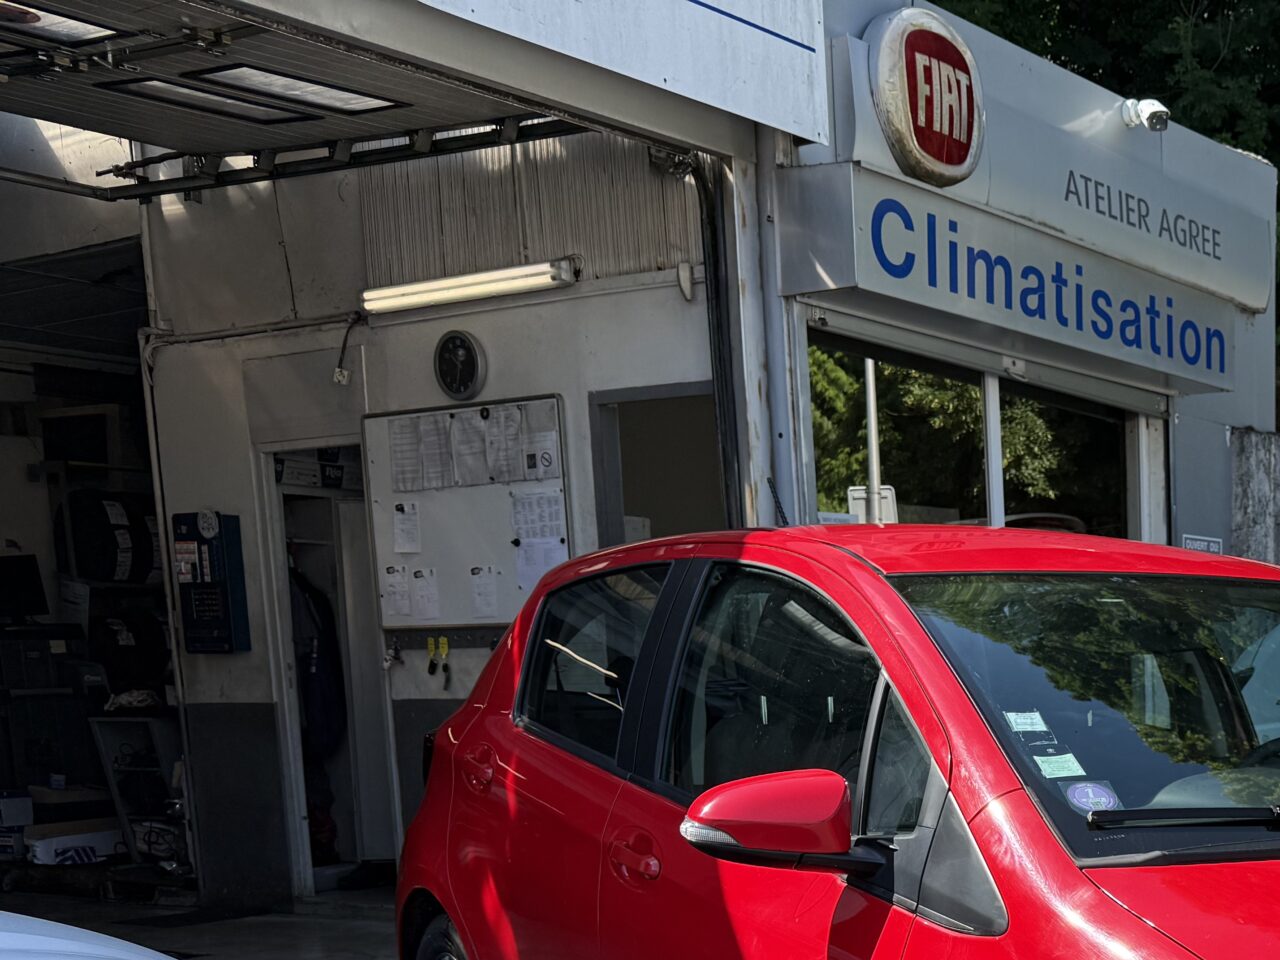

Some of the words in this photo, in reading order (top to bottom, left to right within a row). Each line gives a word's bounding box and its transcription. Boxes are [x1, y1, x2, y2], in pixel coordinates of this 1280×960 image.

[915, 53, 970, 144] FIAT
[1064, 170, 1151, 233] ATELIER
[1158, 208, 1222, 261] AGREE
[871, 198, 1226, 374] Climatisation
